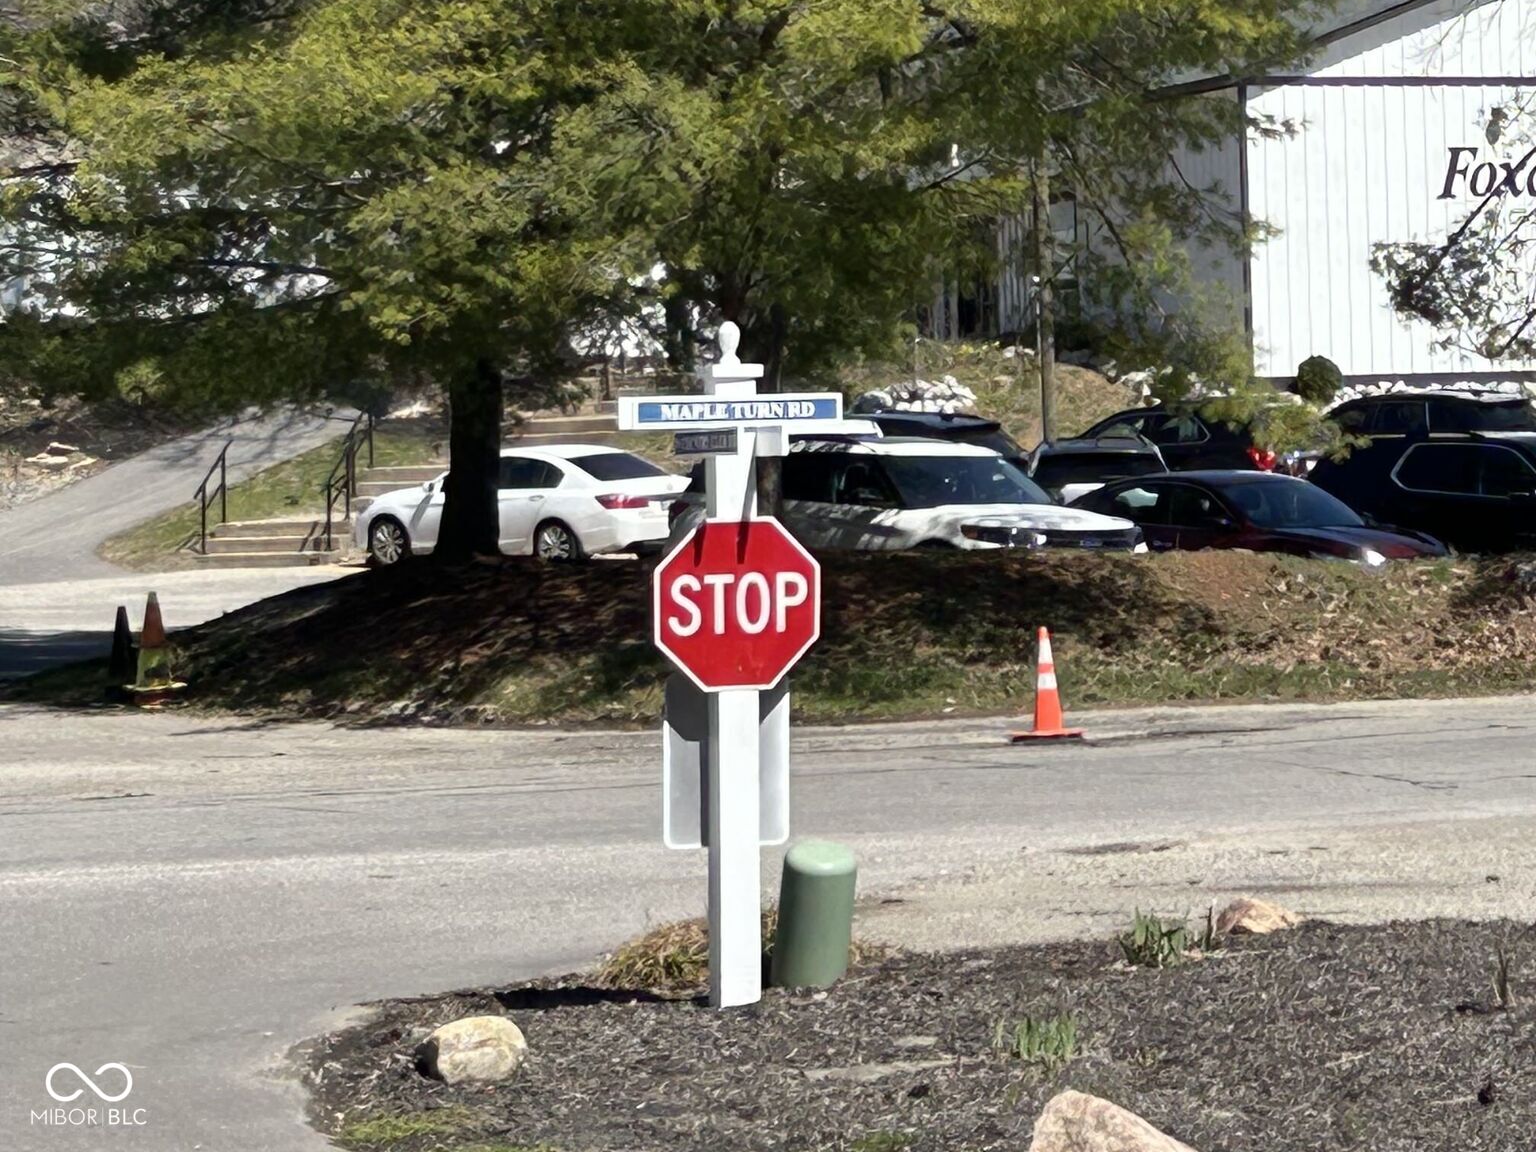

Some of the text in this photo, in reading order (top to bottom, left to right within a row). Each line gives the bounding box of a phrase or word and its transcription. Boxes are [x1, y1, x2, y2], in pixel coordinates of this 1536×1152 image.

[660, 400, 816, 421] MAPLE TURN RD
[668, 572, 808, 637] STOP
